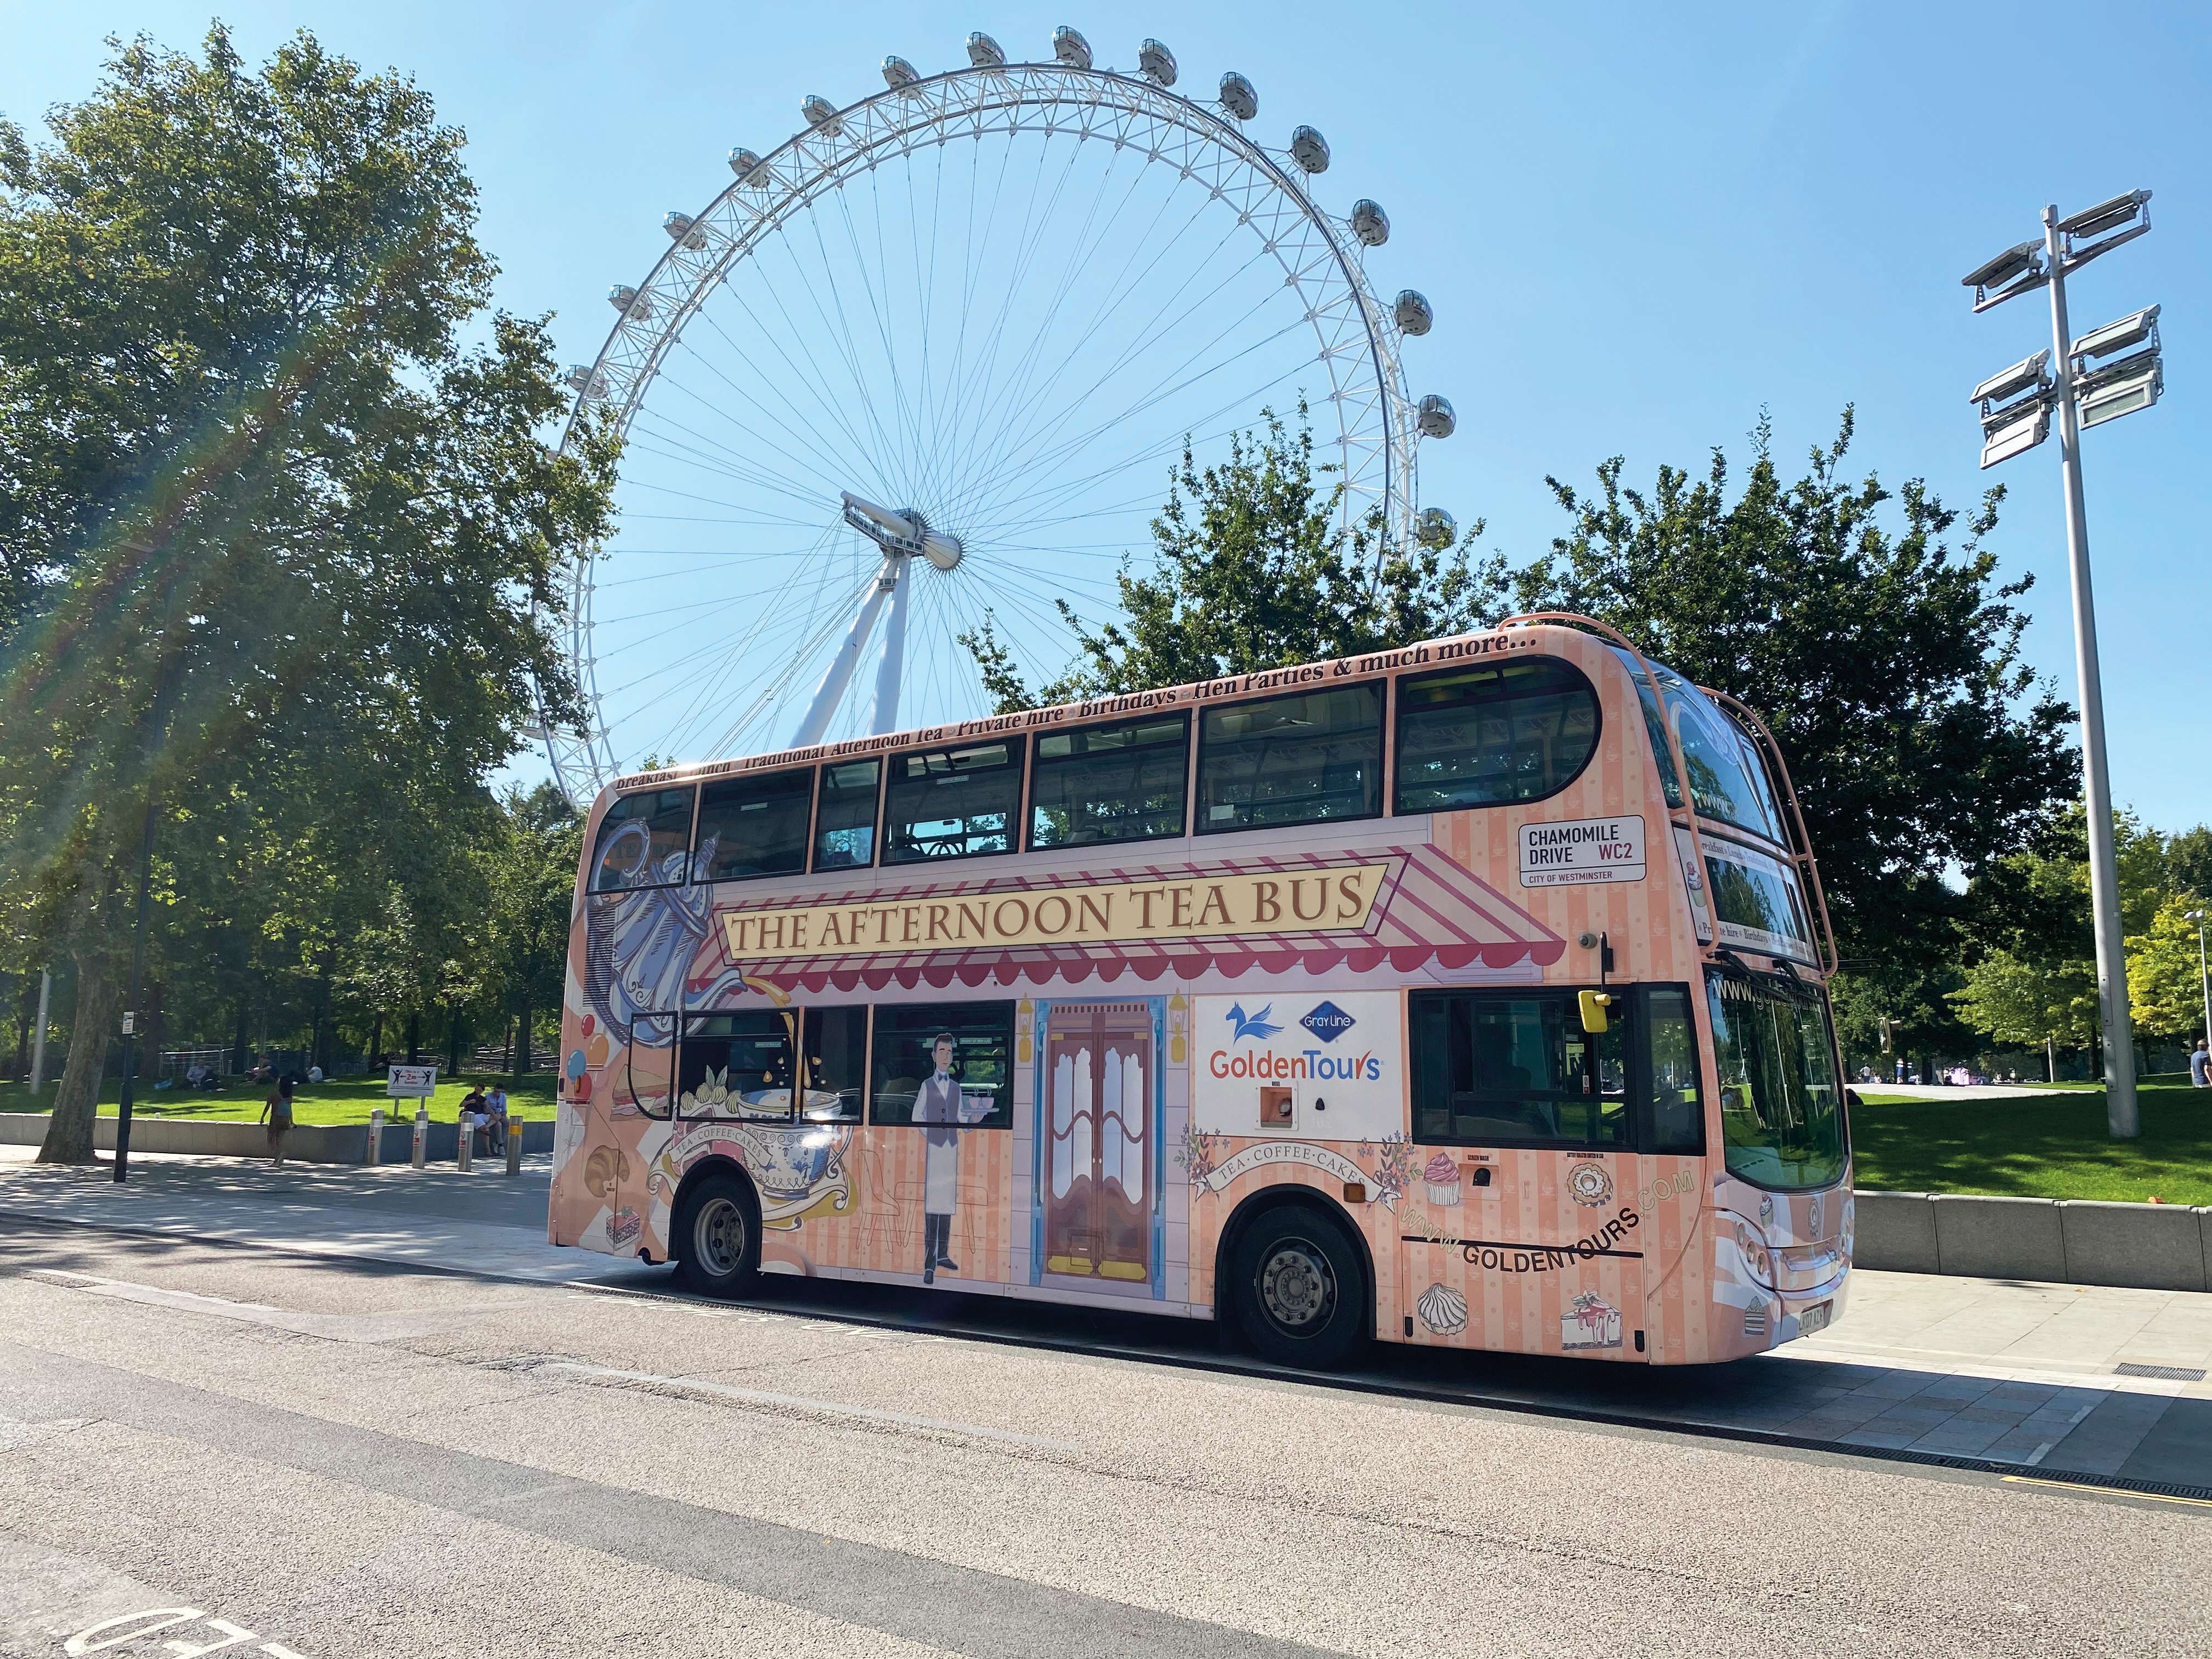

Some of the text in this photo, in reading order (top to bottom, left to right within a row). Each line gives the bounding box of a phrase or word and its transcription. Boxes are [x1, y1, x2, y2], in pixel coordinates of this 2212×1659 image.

[830, 734, 910, 756] Afternoon
[957, 715, 1022, 737] Private
[1027, 708, 1064, 725] hire
[1079, 689, 1177, 717] Birthdays
[1193, 680, 1238, 699] Hen
[1243, 665, 1324, 691] Parties
[1334, 658, 1351, 676] &
[1359, 644, 1430, 673] much
[1529, 825, 1619, 846] CHAMOMILE
[1530, 843, 1633, 865] DRIVE WC2
[1558, 871, 1612, 882] WESTMINSTER
[731, 871, 1363, 951] THE AFTERNOON TEA BUS
[1305, 1015, 1350, 1026] Gray Line
[1210, 1049, 1381, 1080] GoldenTours
[676, 1127, 762, 1158] TEA COFFEE CAKES
[1218, 1158, 1245, 1181] TEA
[1254, 1146, 1311, 1161] COFFEE
